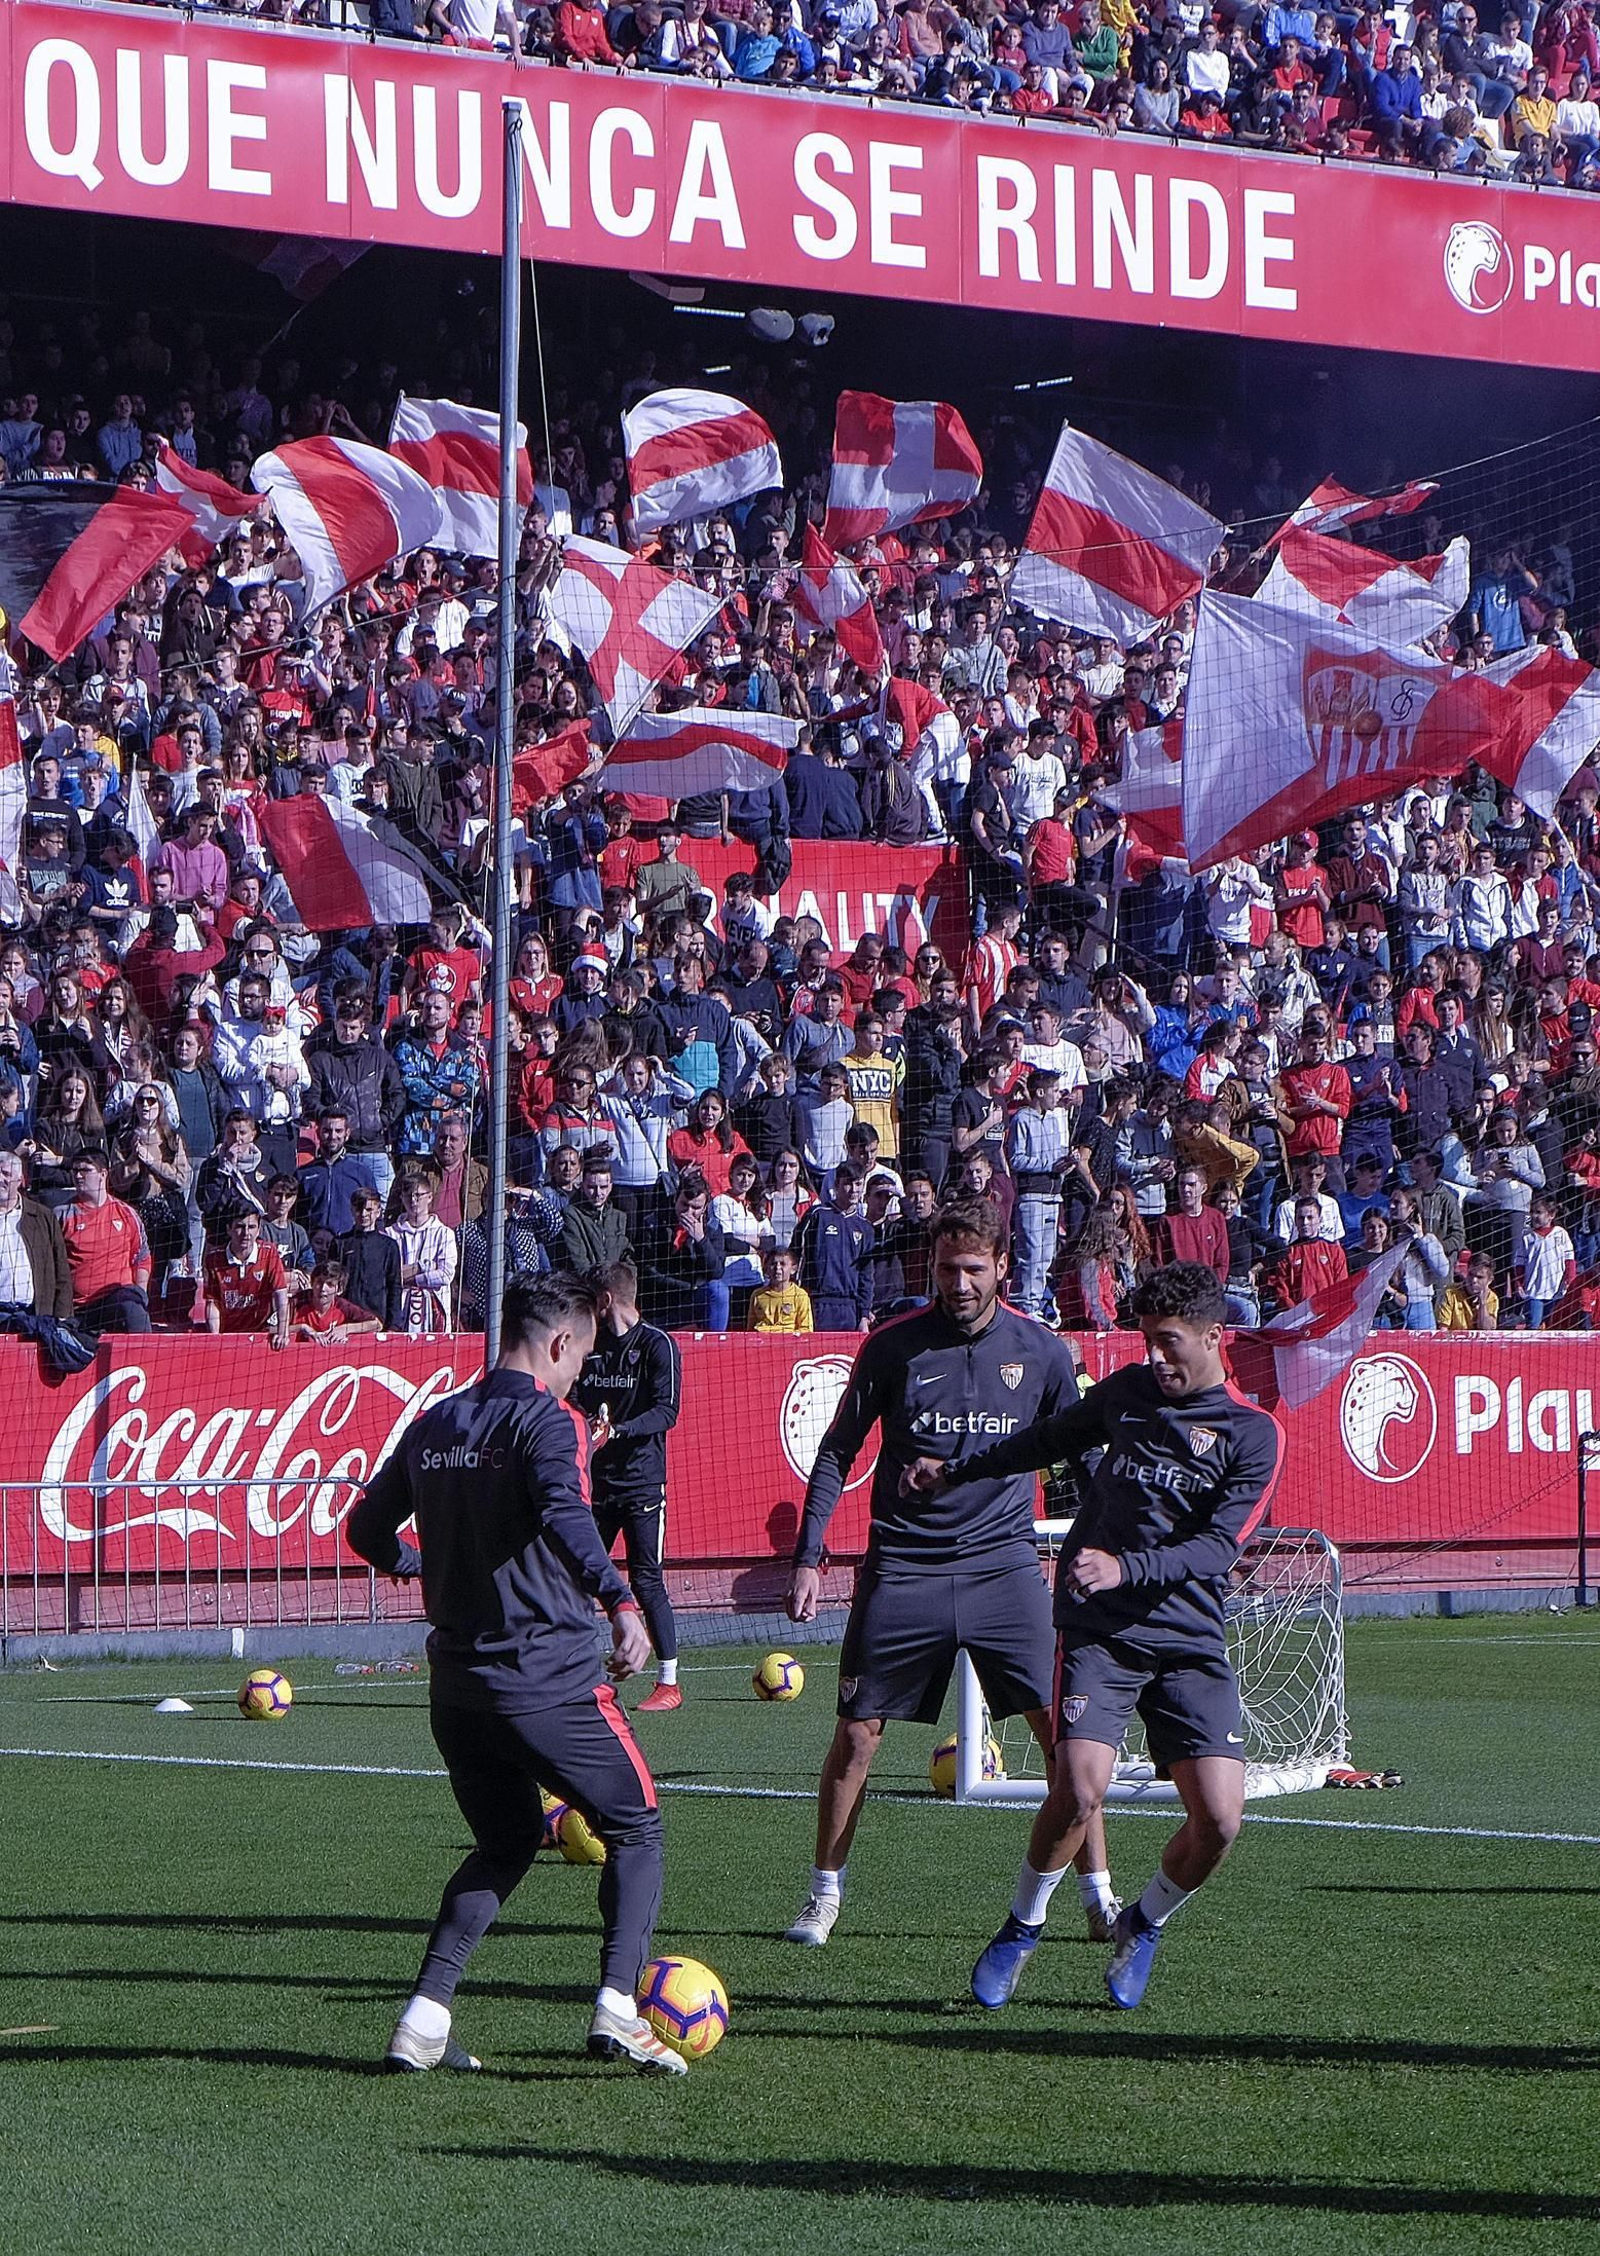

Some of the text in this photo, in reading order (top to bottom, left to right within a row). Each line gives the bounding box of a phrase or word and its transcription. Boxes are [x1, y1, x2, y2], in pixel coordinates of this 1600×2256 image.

[23, 37, 1298, 311] QUE NUNCA SE RINDE
[850, 1070, 891, 1092] NYC
[594, 1373, 637, 1389] betfair
[935, 1411, 1019, 1435] betfair
[39, 1364, 484, 1541] Coca-Col
[1125, 1455, 1215, 1494] betfair
